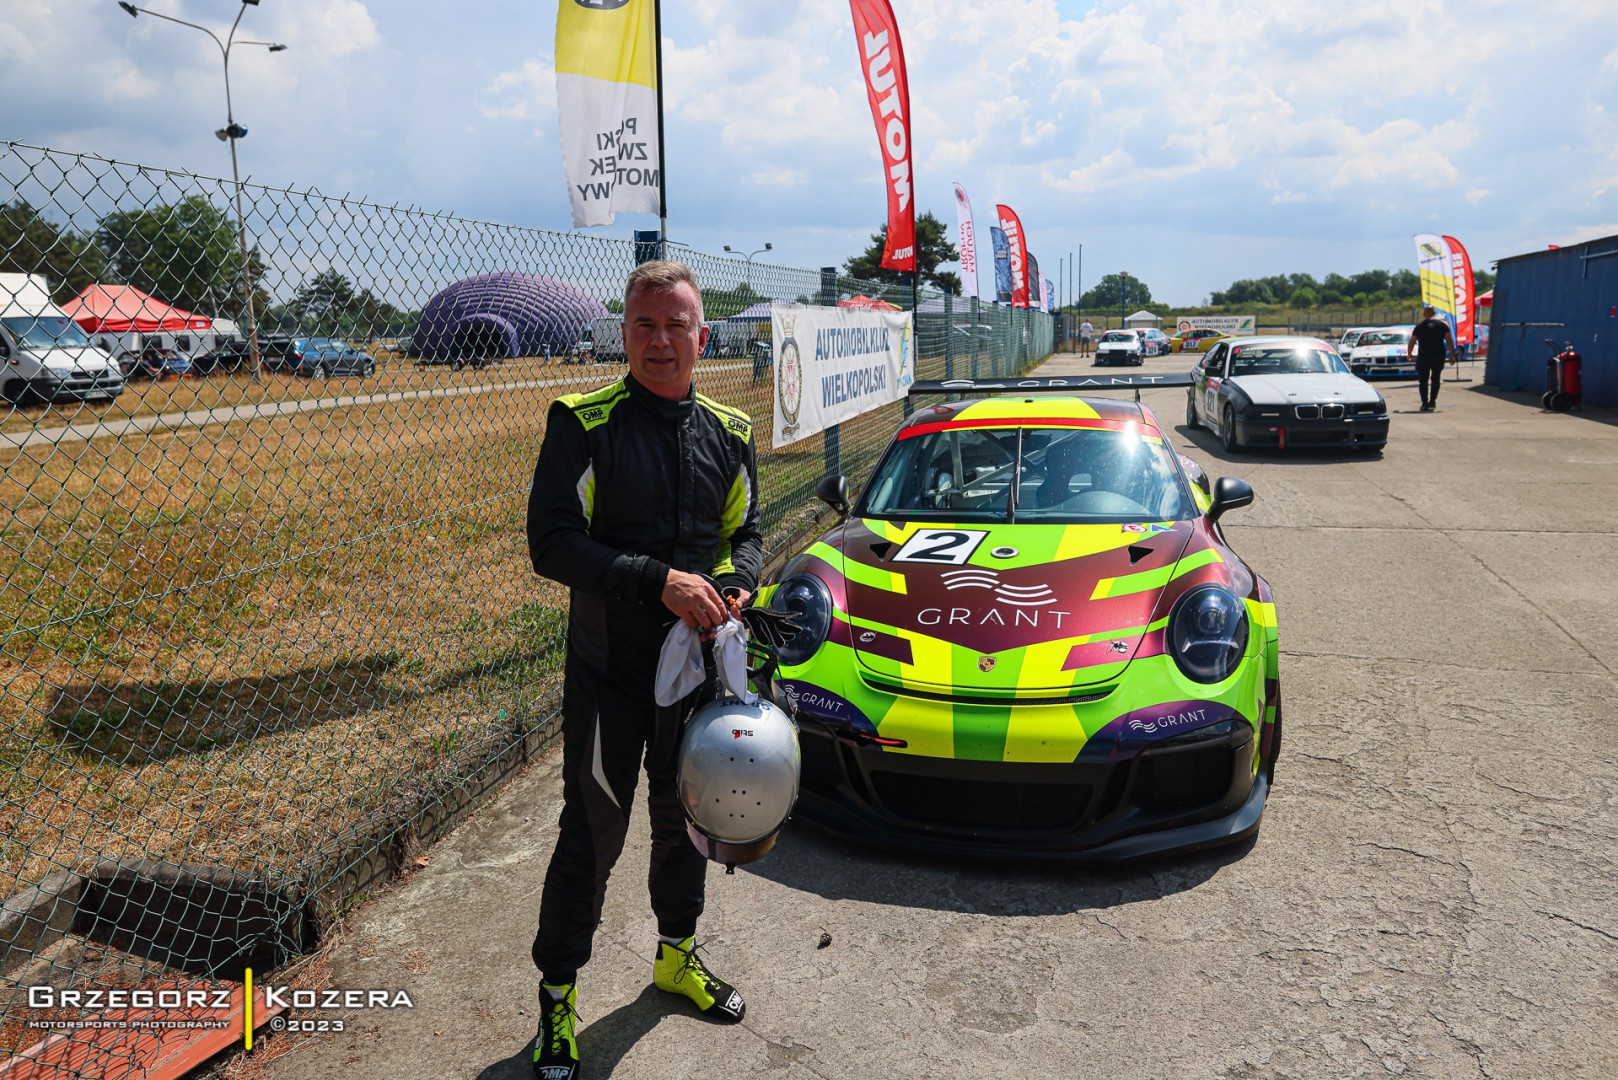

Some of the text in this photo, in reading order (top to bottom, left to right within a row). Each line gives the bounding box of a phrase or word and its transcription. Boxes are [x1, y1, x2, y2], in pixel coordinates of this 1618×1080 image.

[815, 327, 890, 361] AUTOMOBILKLUB
[821, 364, 886, 408] WIELKOPOLSKI
[1017, 376, 1165, 387] GRANT
[582, 410, 604, 421] OMP
[728, 419, 748, 433] OMP
[906, 530, 970, 563] 2
[917, 607, 1072, 629] GRANT
[801, 692, 844, 713] GRANT
[1158, 709, 1206, 728] GRANT
[729, 992, 743, 1010] OM
